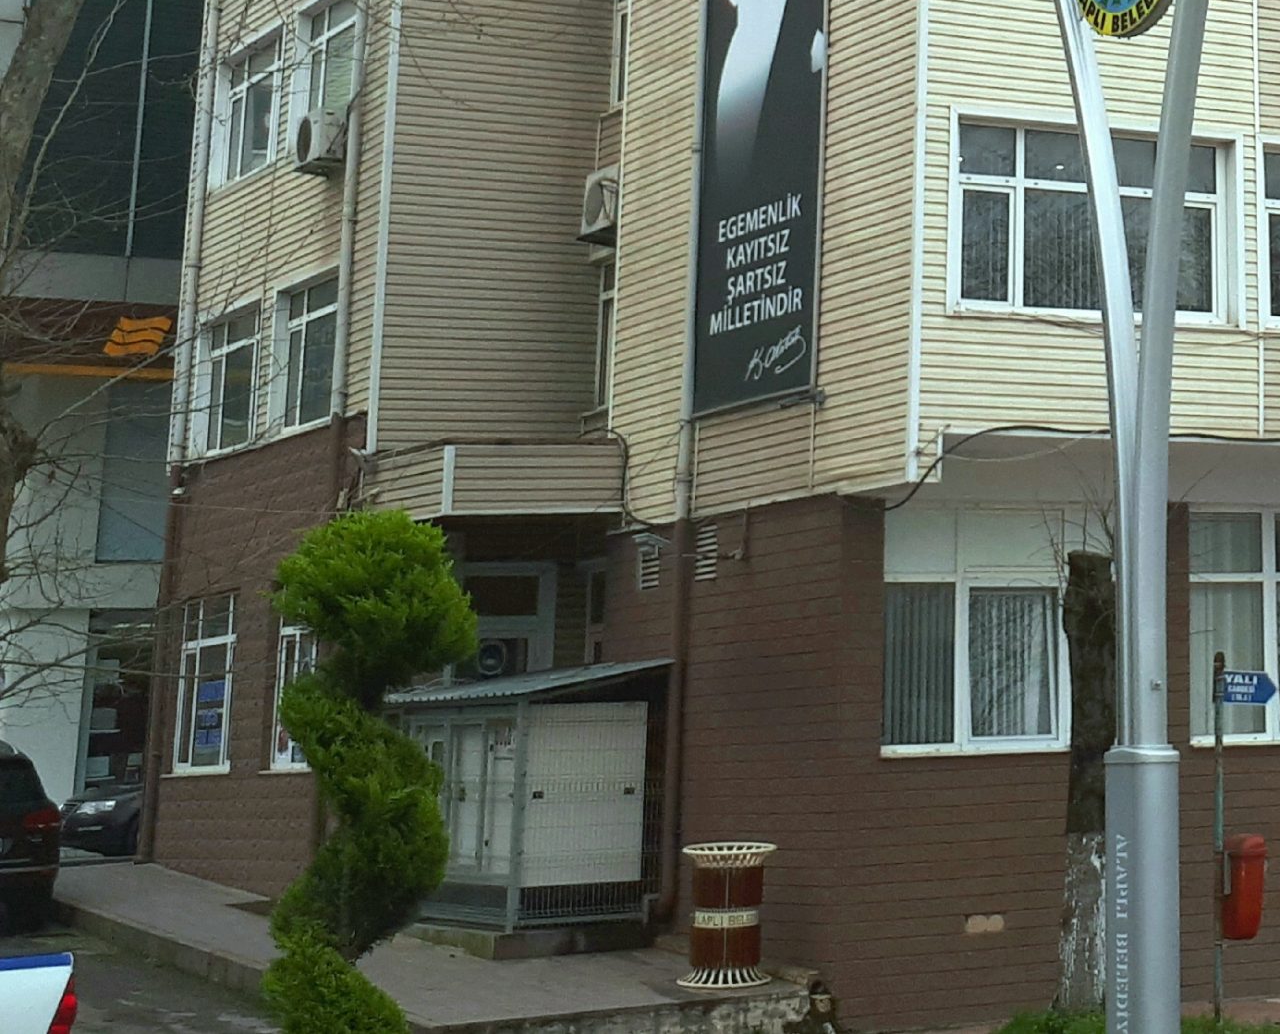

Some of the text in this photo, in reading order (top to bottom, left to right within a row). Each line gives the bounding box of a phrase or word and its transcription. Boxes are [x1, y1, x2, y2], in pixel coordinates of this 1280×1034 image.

[718, 192, 802, 243] EGEMENLİK
[726, 228, 791, 270] KAYITSIZ
[726, 261, 787, 306] ŞARTSIZ
[709, 285, 803, 336] MİLLETİNDİR
[1224, 674, 1258, 685] YALI
[1115, 833, 1131, 919] ALAPLI
